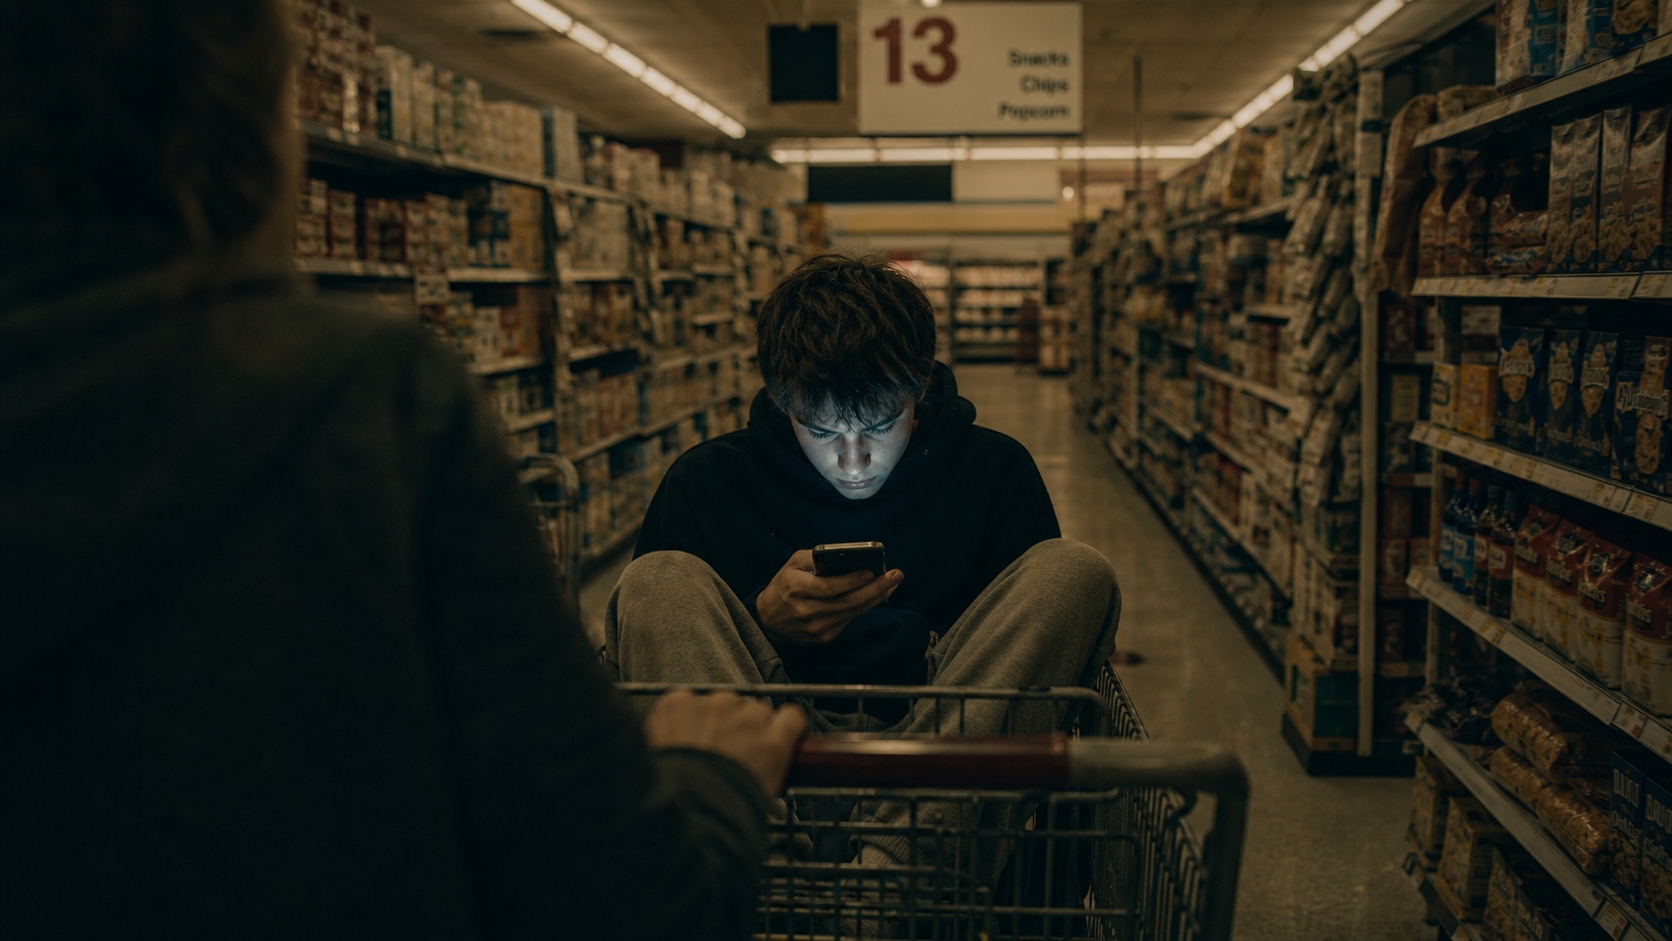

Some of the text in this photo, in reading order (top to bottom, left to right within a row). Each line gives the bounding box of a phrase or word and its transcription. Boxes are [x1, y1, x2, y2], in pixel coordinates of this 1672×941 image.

[873, 17, 957, 84] 13
[1008, 49, 1069, 66] Snacks
[1020, 75, 1069, 95] Chips
[998, 102, 1069, 120] Popcorn
